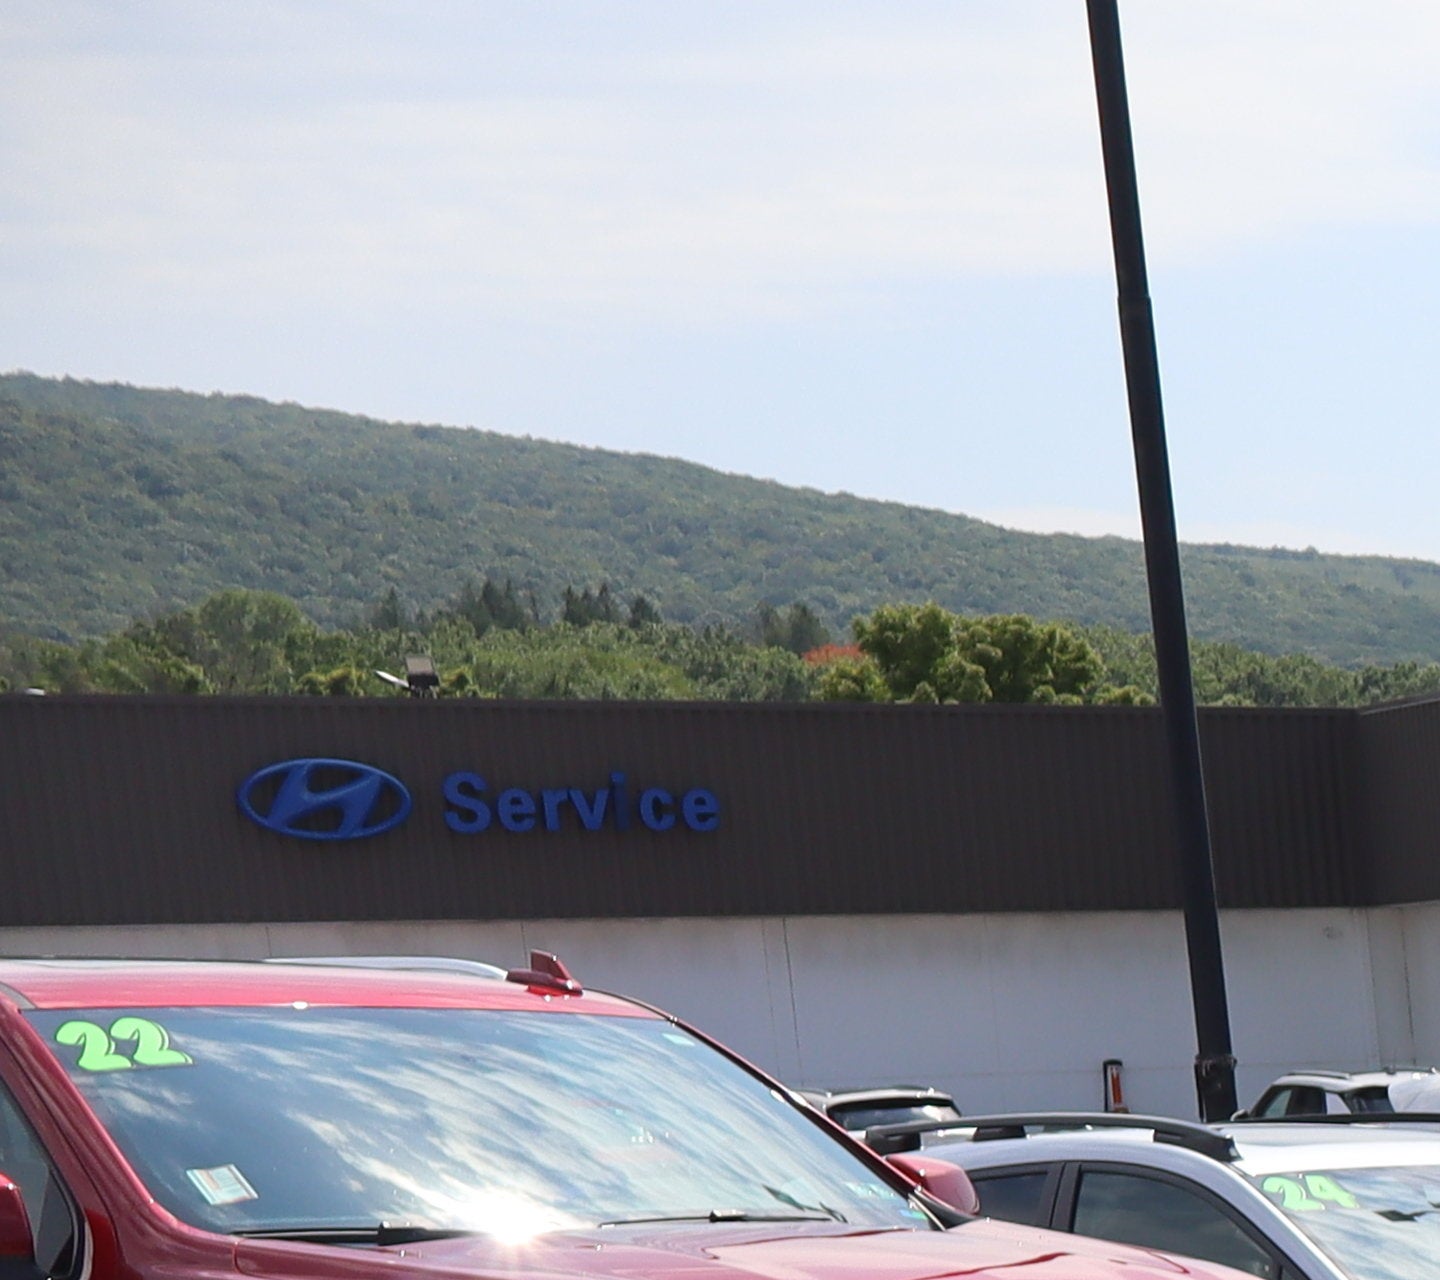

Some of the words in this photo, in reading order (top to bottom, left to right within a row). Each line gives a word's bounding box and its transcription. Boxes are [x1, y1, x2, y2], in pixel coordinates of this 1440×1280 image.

[443, 770, 720, 834] Service
[55, 1016, 194, 1072] 22
[1262, 1174, 1360, 1212] 24
